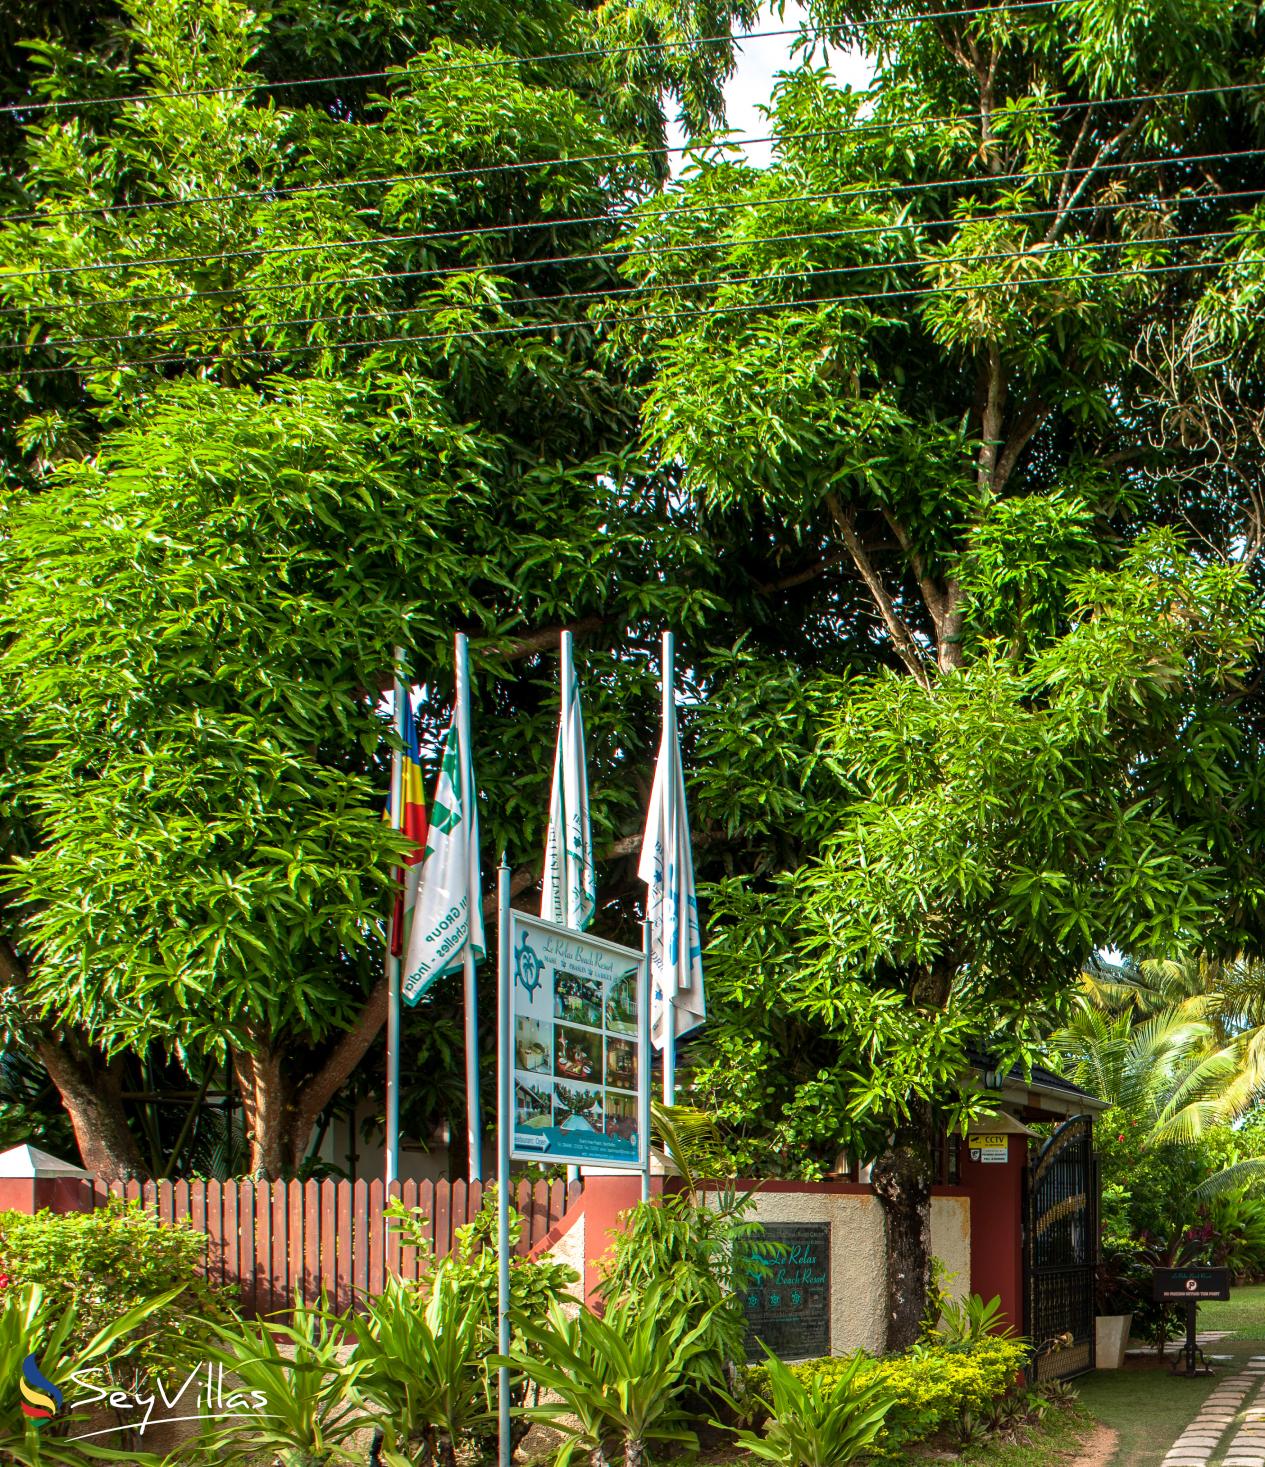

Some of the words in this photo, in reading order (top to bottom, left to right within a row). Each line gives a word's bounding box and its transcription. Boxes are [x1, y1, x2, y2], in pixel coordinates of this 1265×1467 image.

[985, 1136, 1004, 1144] CCTV
[789, 1244, 816, 1265] Relax
[776, 1268, 801, 1285] Beach
[802, 1267, 826, 1284] Resort
